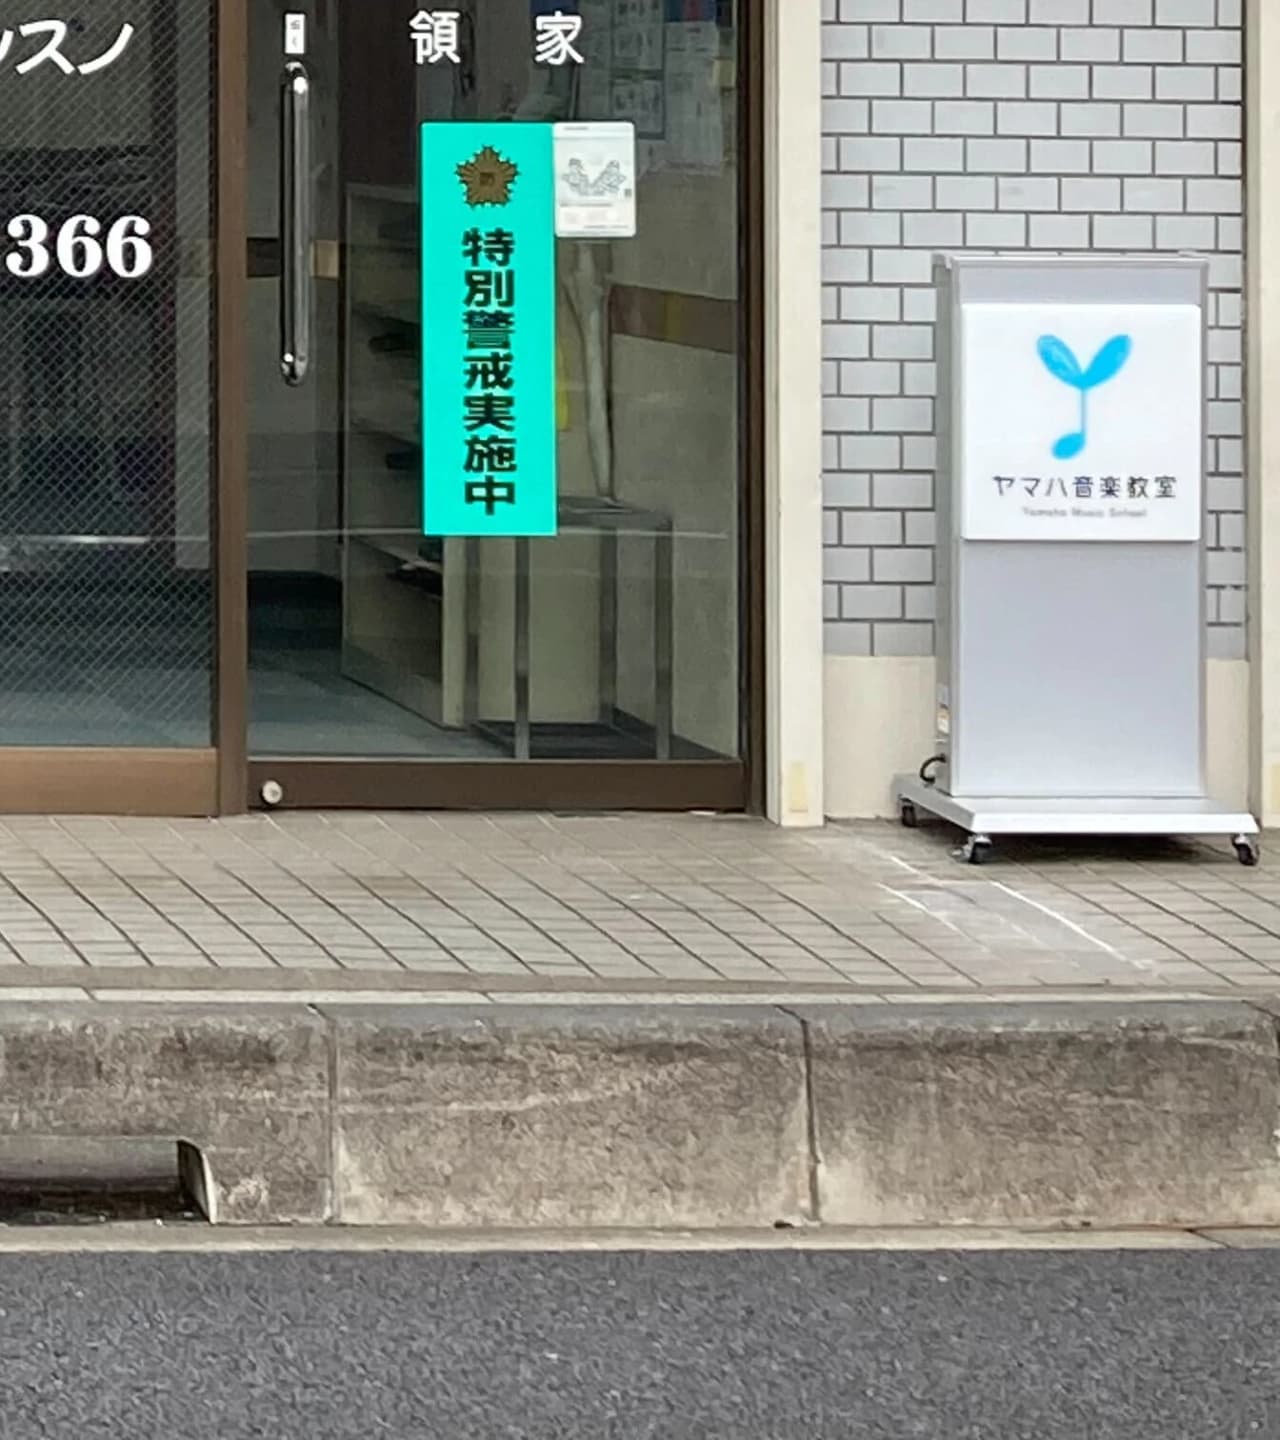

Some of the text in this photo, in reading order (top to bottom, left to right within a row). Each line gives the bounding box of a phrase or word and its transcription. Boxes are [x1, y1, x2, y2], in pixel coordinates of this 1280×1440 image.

[408, 9, 585, 66] 領家
[462, 227, 517, 515] 特別警戒実施中
[992, 475, 1177, 499] ヤマハ音楽教室
